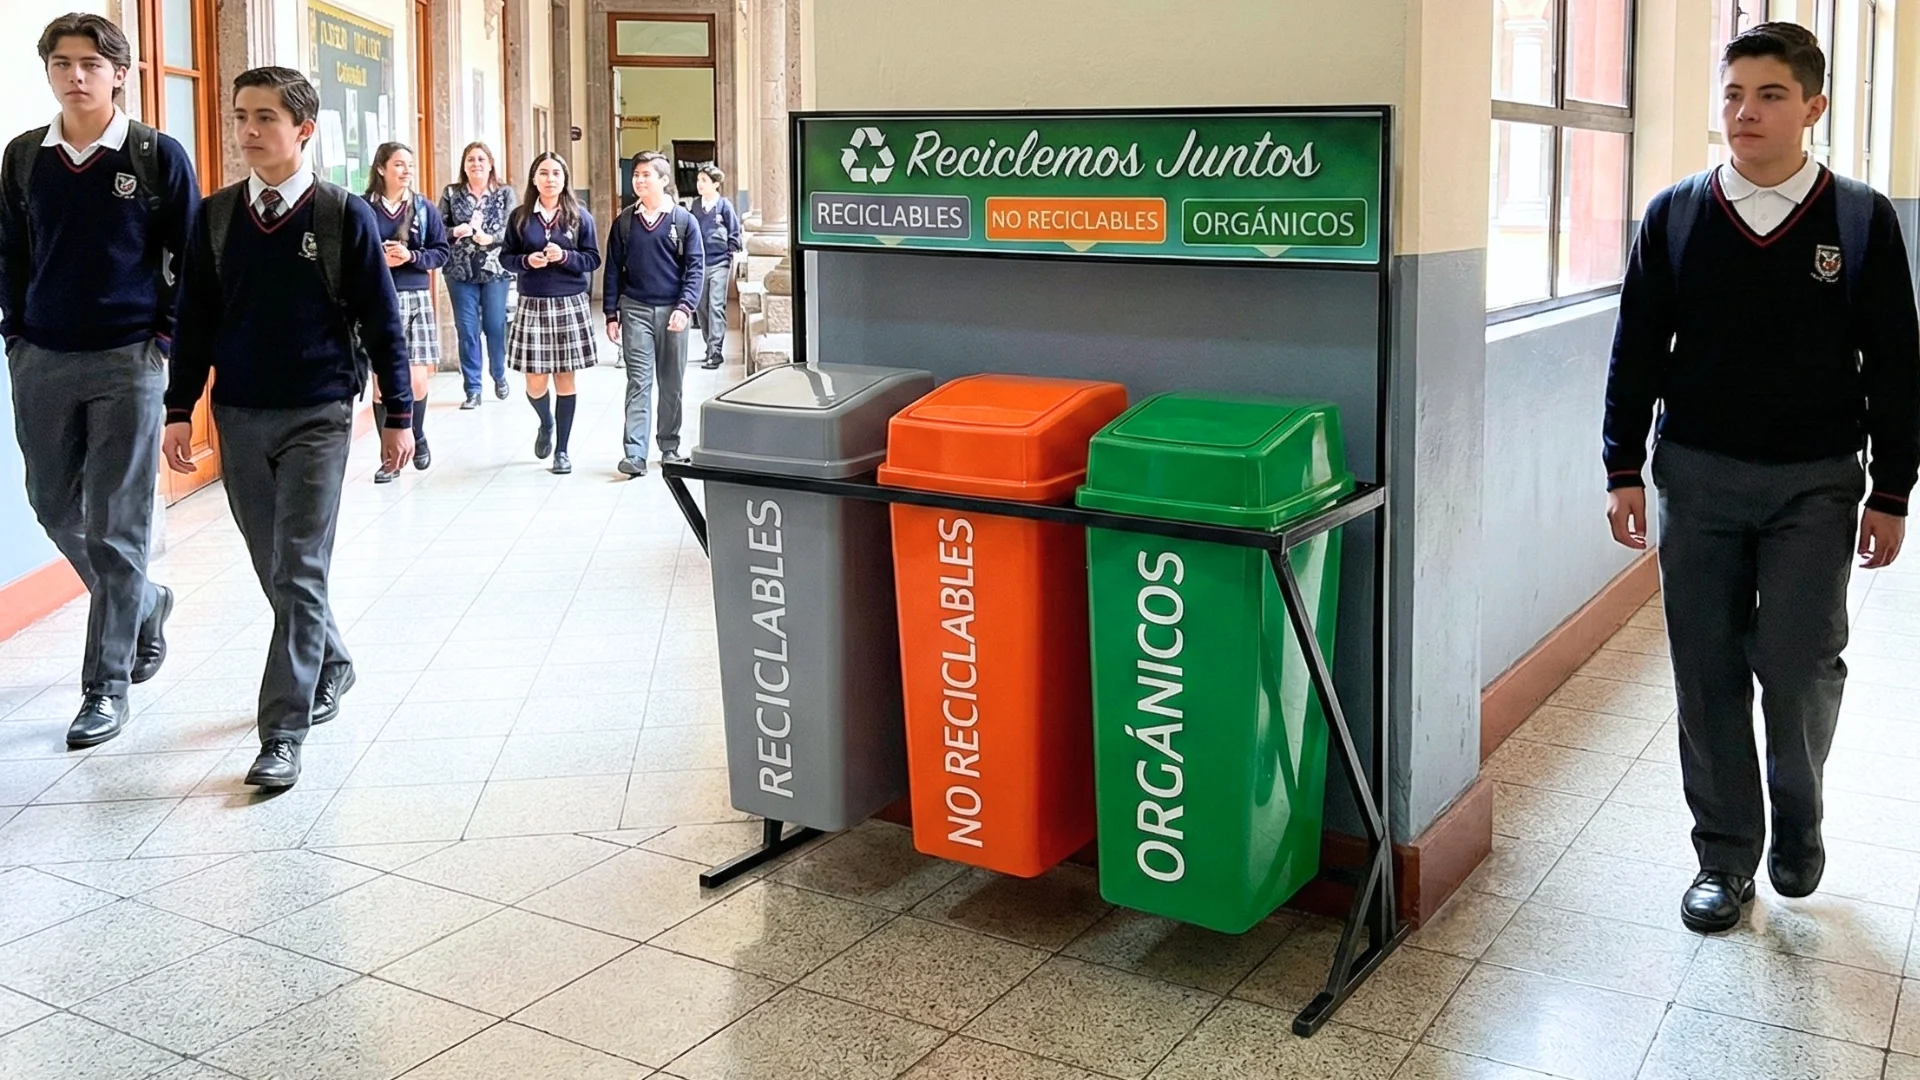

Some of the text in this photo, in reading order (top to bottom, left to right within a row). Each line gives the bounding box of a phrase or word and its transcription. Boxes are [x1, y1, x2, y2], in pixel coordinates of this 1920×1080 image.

[907, 129, 1320, 177] Reciclemos Juntos
[817, 202, 963, 229] RECICLABLES
[992, 211, 1160, 231] NO RECICLABLES
[1192, 205, 1355, 236] ORGÁNICOS
[746, 499, 794, 798] RECICLABLES
[938, 518, 983, 848] NO RECICLABLES
[1125, 550, 1185, 882] ORGÁNICOS
